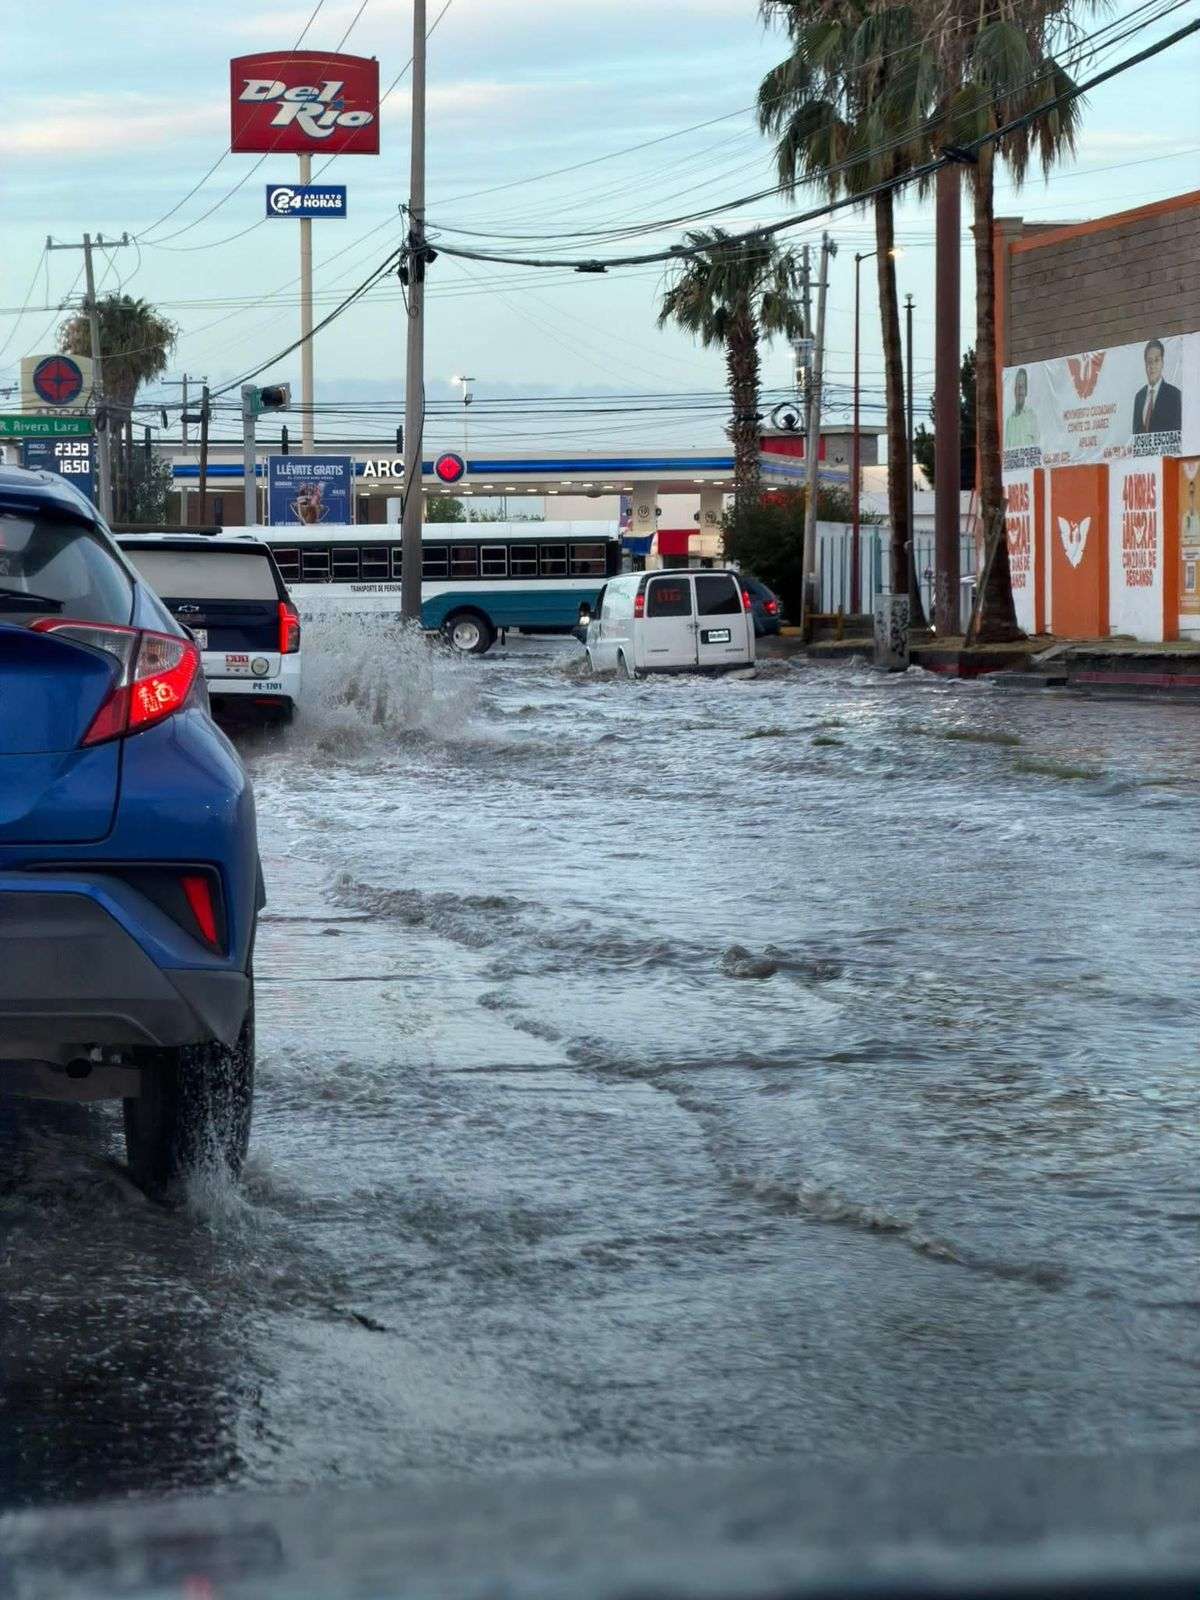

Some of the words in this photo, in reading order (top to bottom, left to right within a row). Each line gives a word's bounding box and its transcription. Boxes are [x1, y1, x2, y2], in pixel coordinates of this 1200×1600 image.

[238, 79, 344, 102] Del
[270, 101, 374, 138] Rio
[277, 194, 302, 209] 24
[304, 199, 343, 208] HORAS
[13, 421, 50, 432] Rivera
[54, 421, 79, 432] Lara
[276, 462, 312, 475] LLÉVATE
[313, 464, 344, 475] GRATIS
[363, 460, 405, 478] ARC
